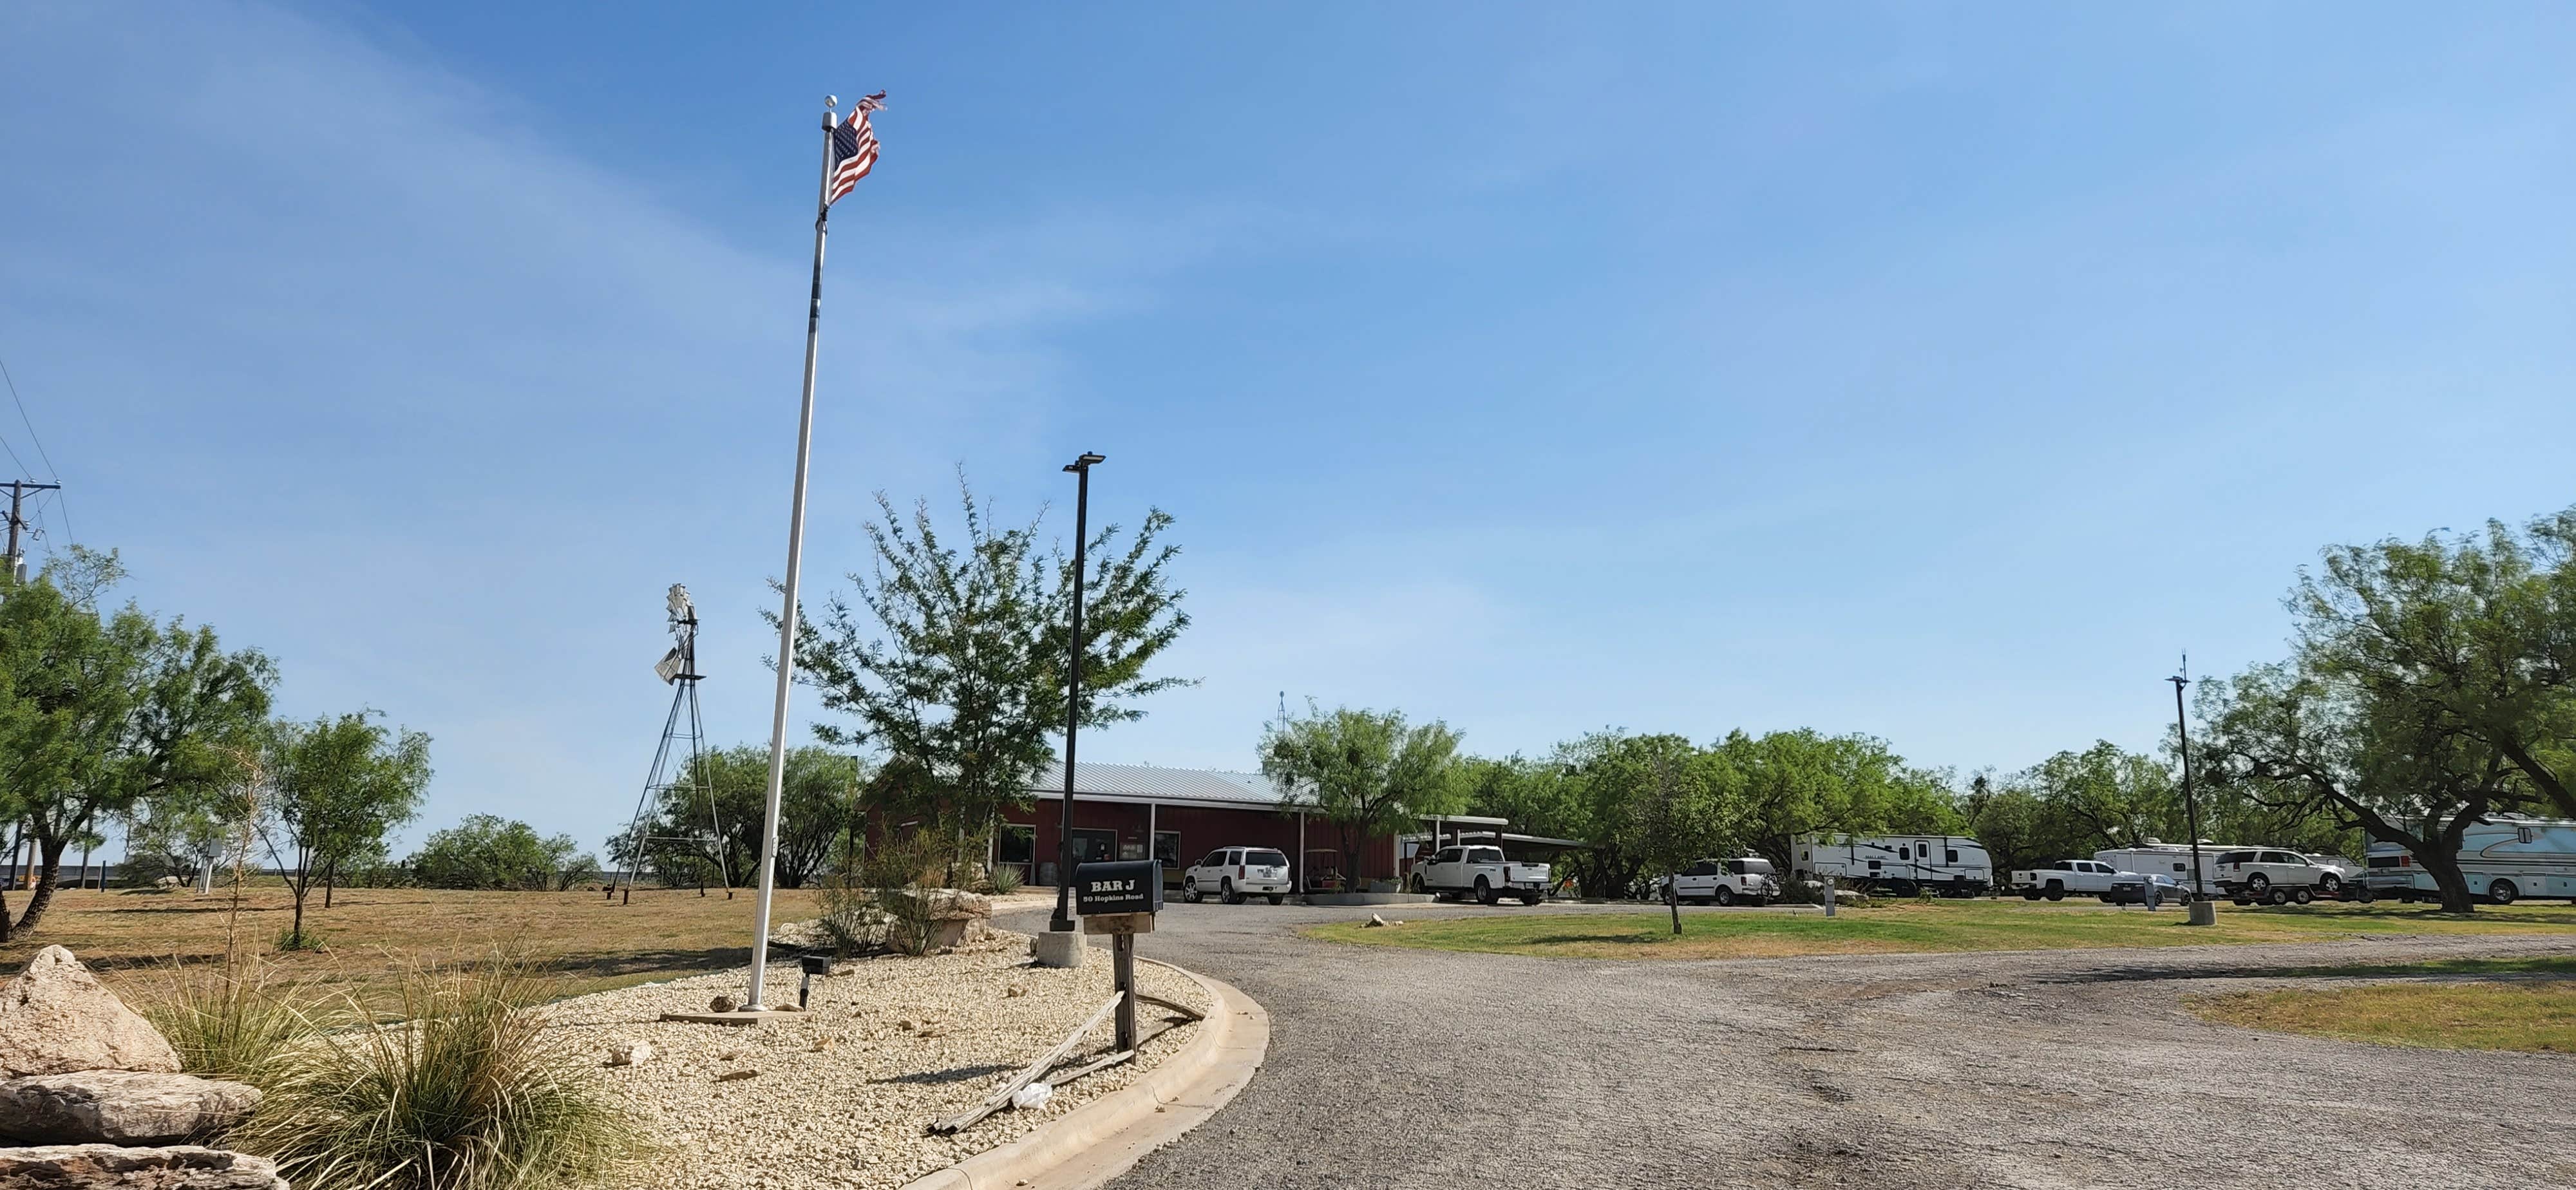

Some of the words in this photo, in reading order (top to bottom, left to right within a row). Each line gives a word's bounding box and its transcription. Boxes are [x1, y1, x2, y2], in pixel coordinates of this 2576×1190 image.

[1091, 880, 1122, 892] BAR
[1125, 880, 1135, 891] J
[1095, 894, 1124, 903] Hopkins
